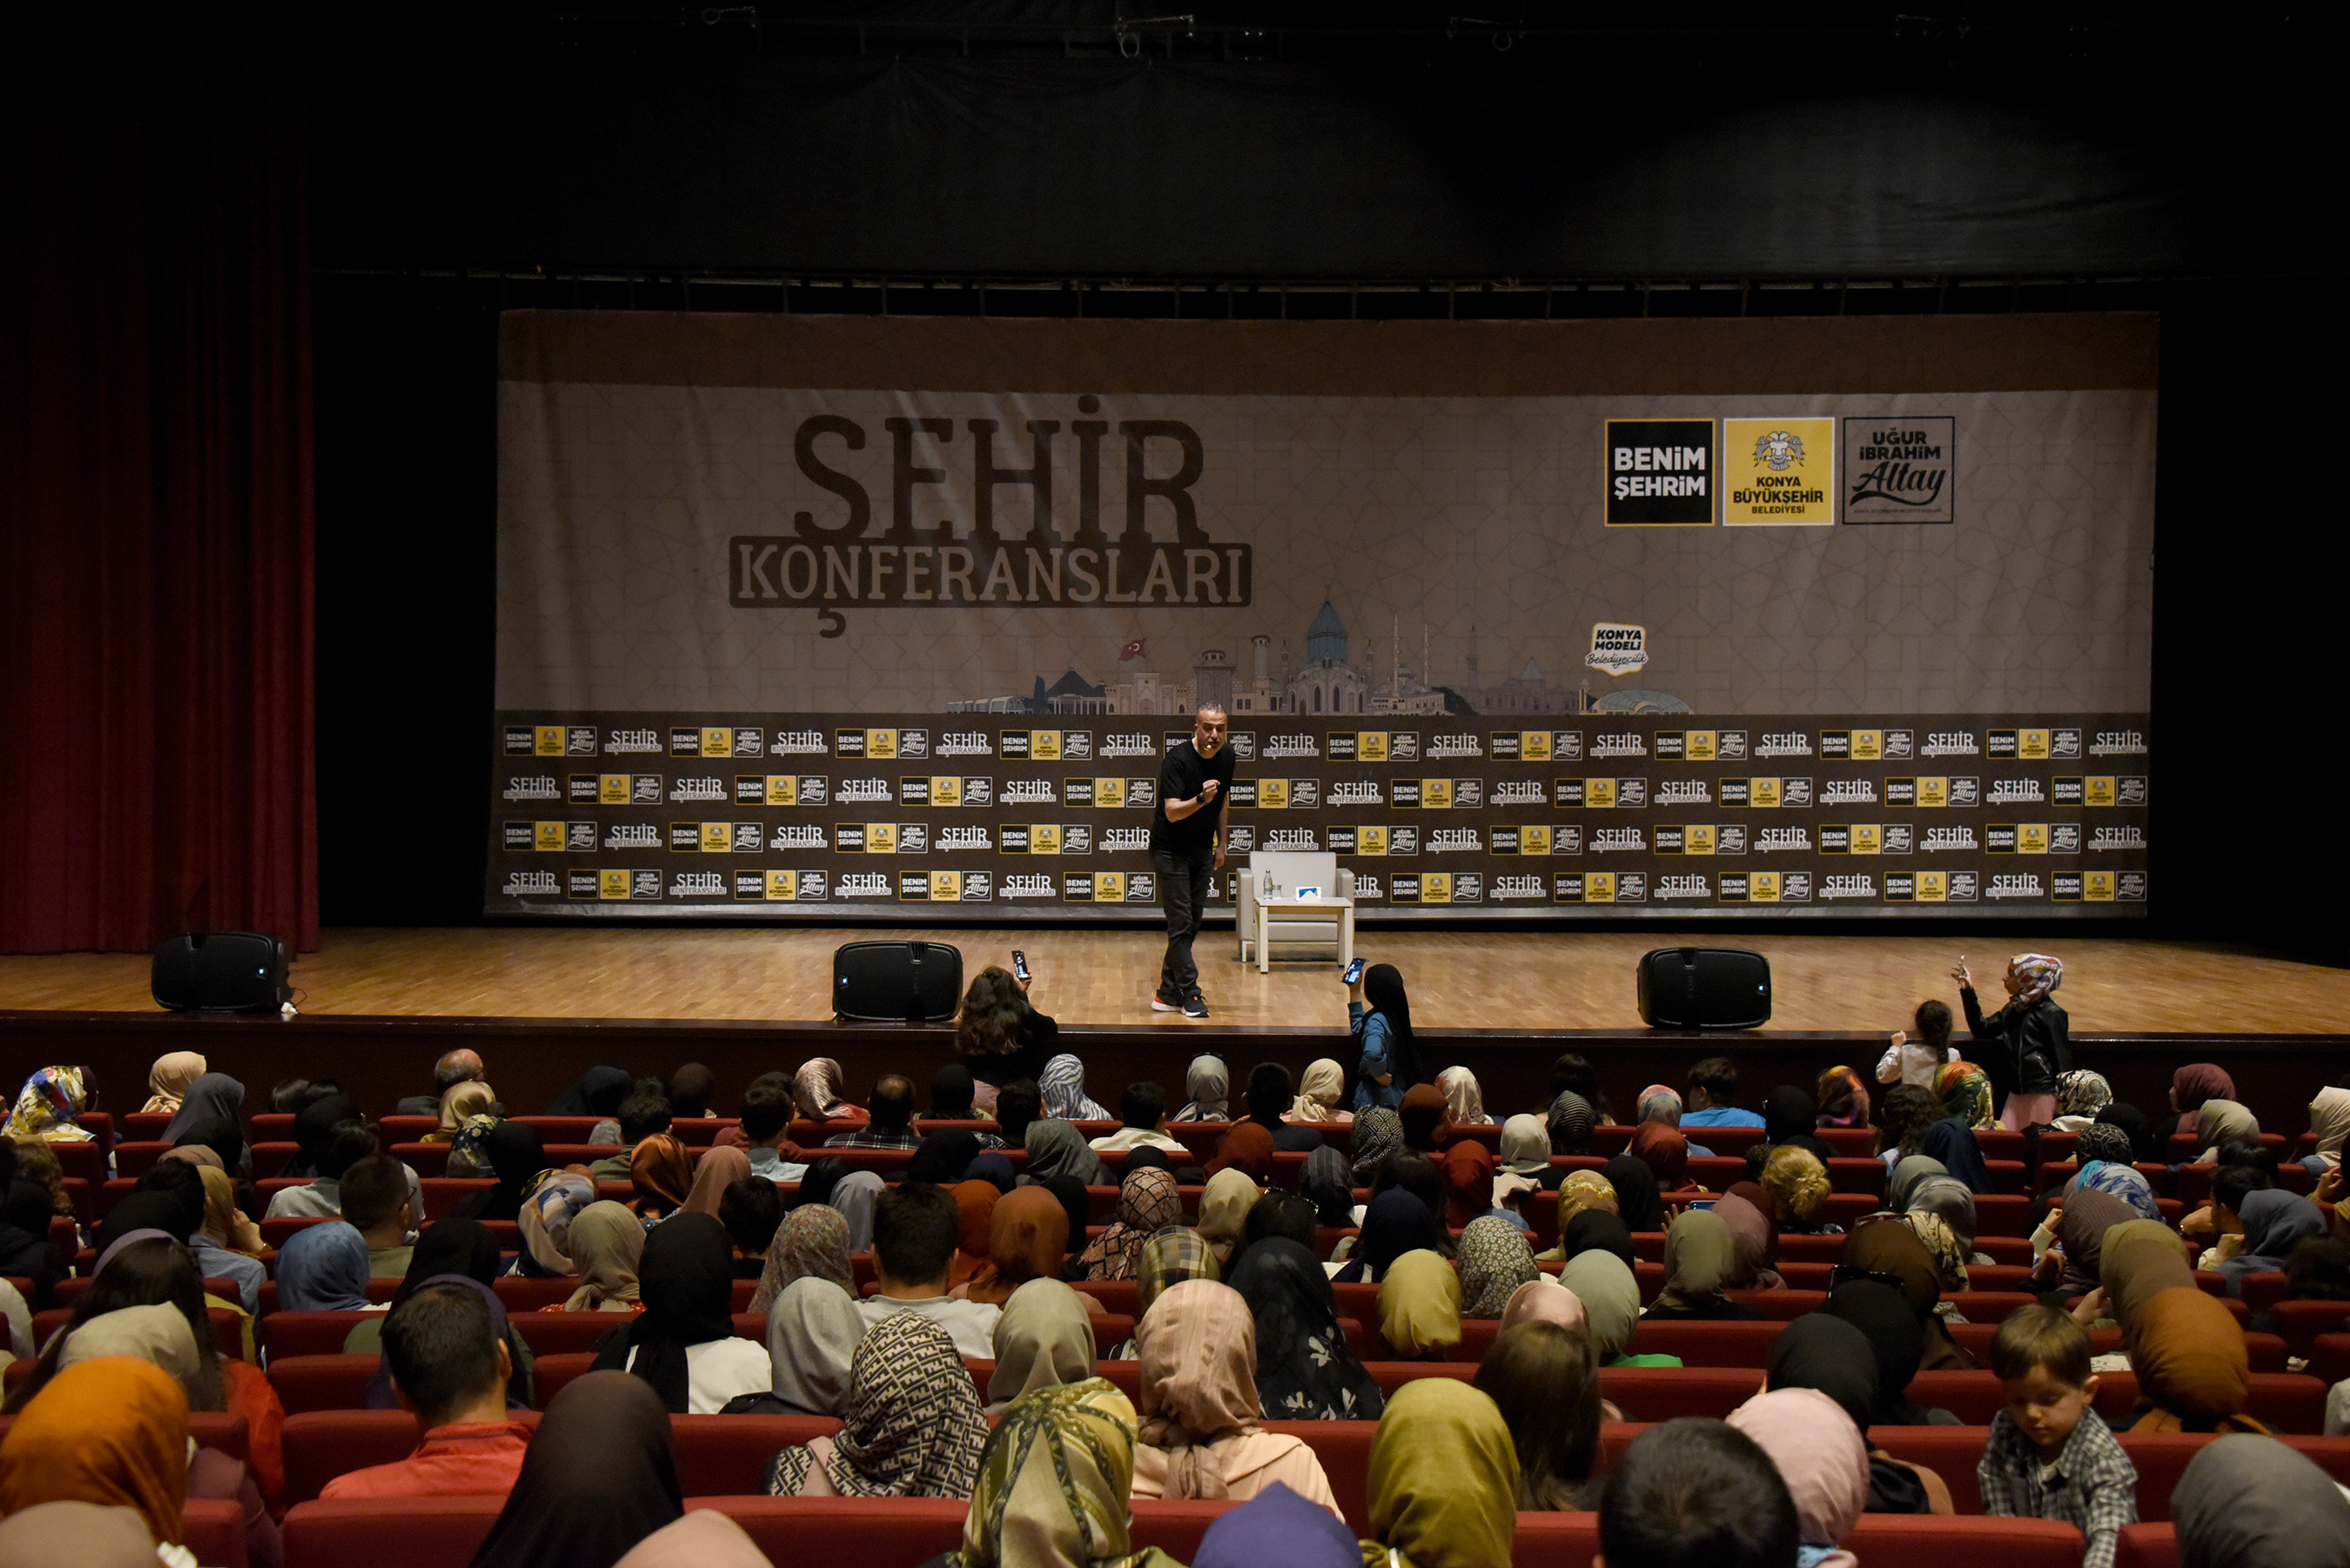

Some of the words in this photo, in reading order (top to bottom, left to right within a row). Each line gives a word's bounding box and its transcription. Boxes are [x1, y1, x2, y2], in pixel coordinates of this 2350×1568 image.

[1872, 427, 1927, 446] UĞUR
[1756, 477, 1802, 487] KONYA
[1850, 461, 1946, 506] Altay
[1733, 488, 1823, 505] BÜYÜKŞEHİR
[1752, 505, 1805, 514] BELEDİYESİ
[738, 544, 1244, 604] KONFERANSLARI
[1596, 630, 1642, 640] KONYA
[1586, 653, 1648, 669] Belediyecilik
